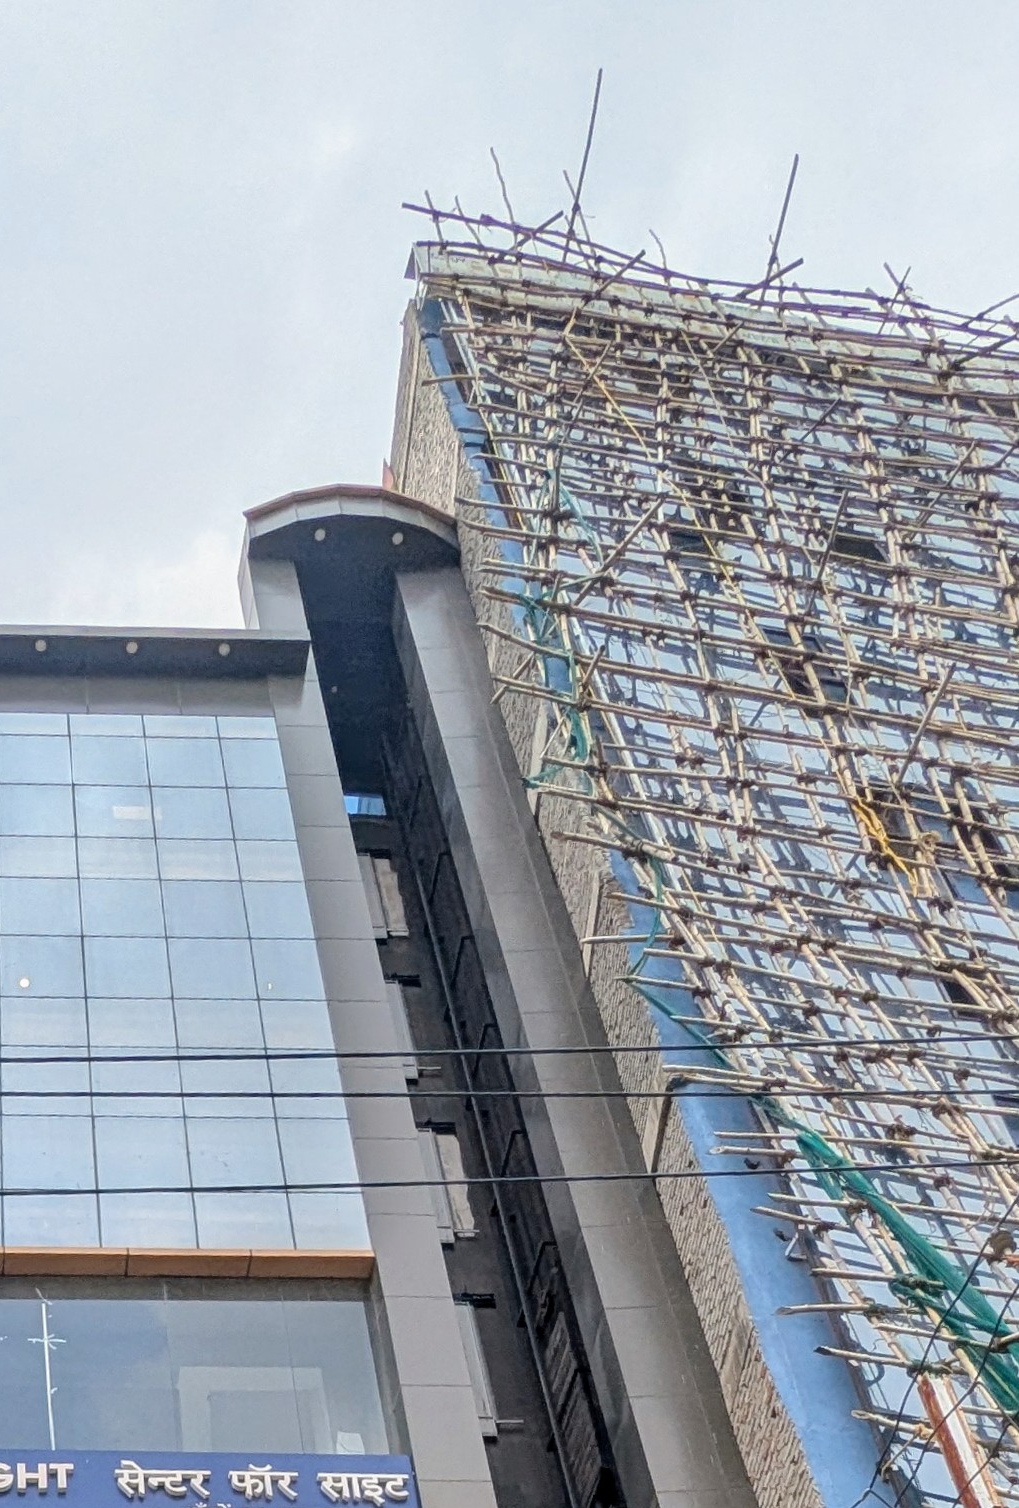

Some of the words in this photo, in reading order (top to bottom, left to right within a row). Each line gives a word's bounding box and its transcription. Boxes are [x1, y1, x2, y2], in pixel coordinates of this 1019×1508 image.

[114, 1460, 211, 1499] सेन्टर
[229, 1464, 298, 1500] फॉर
[317, 1472, 410, 1507] साइट
